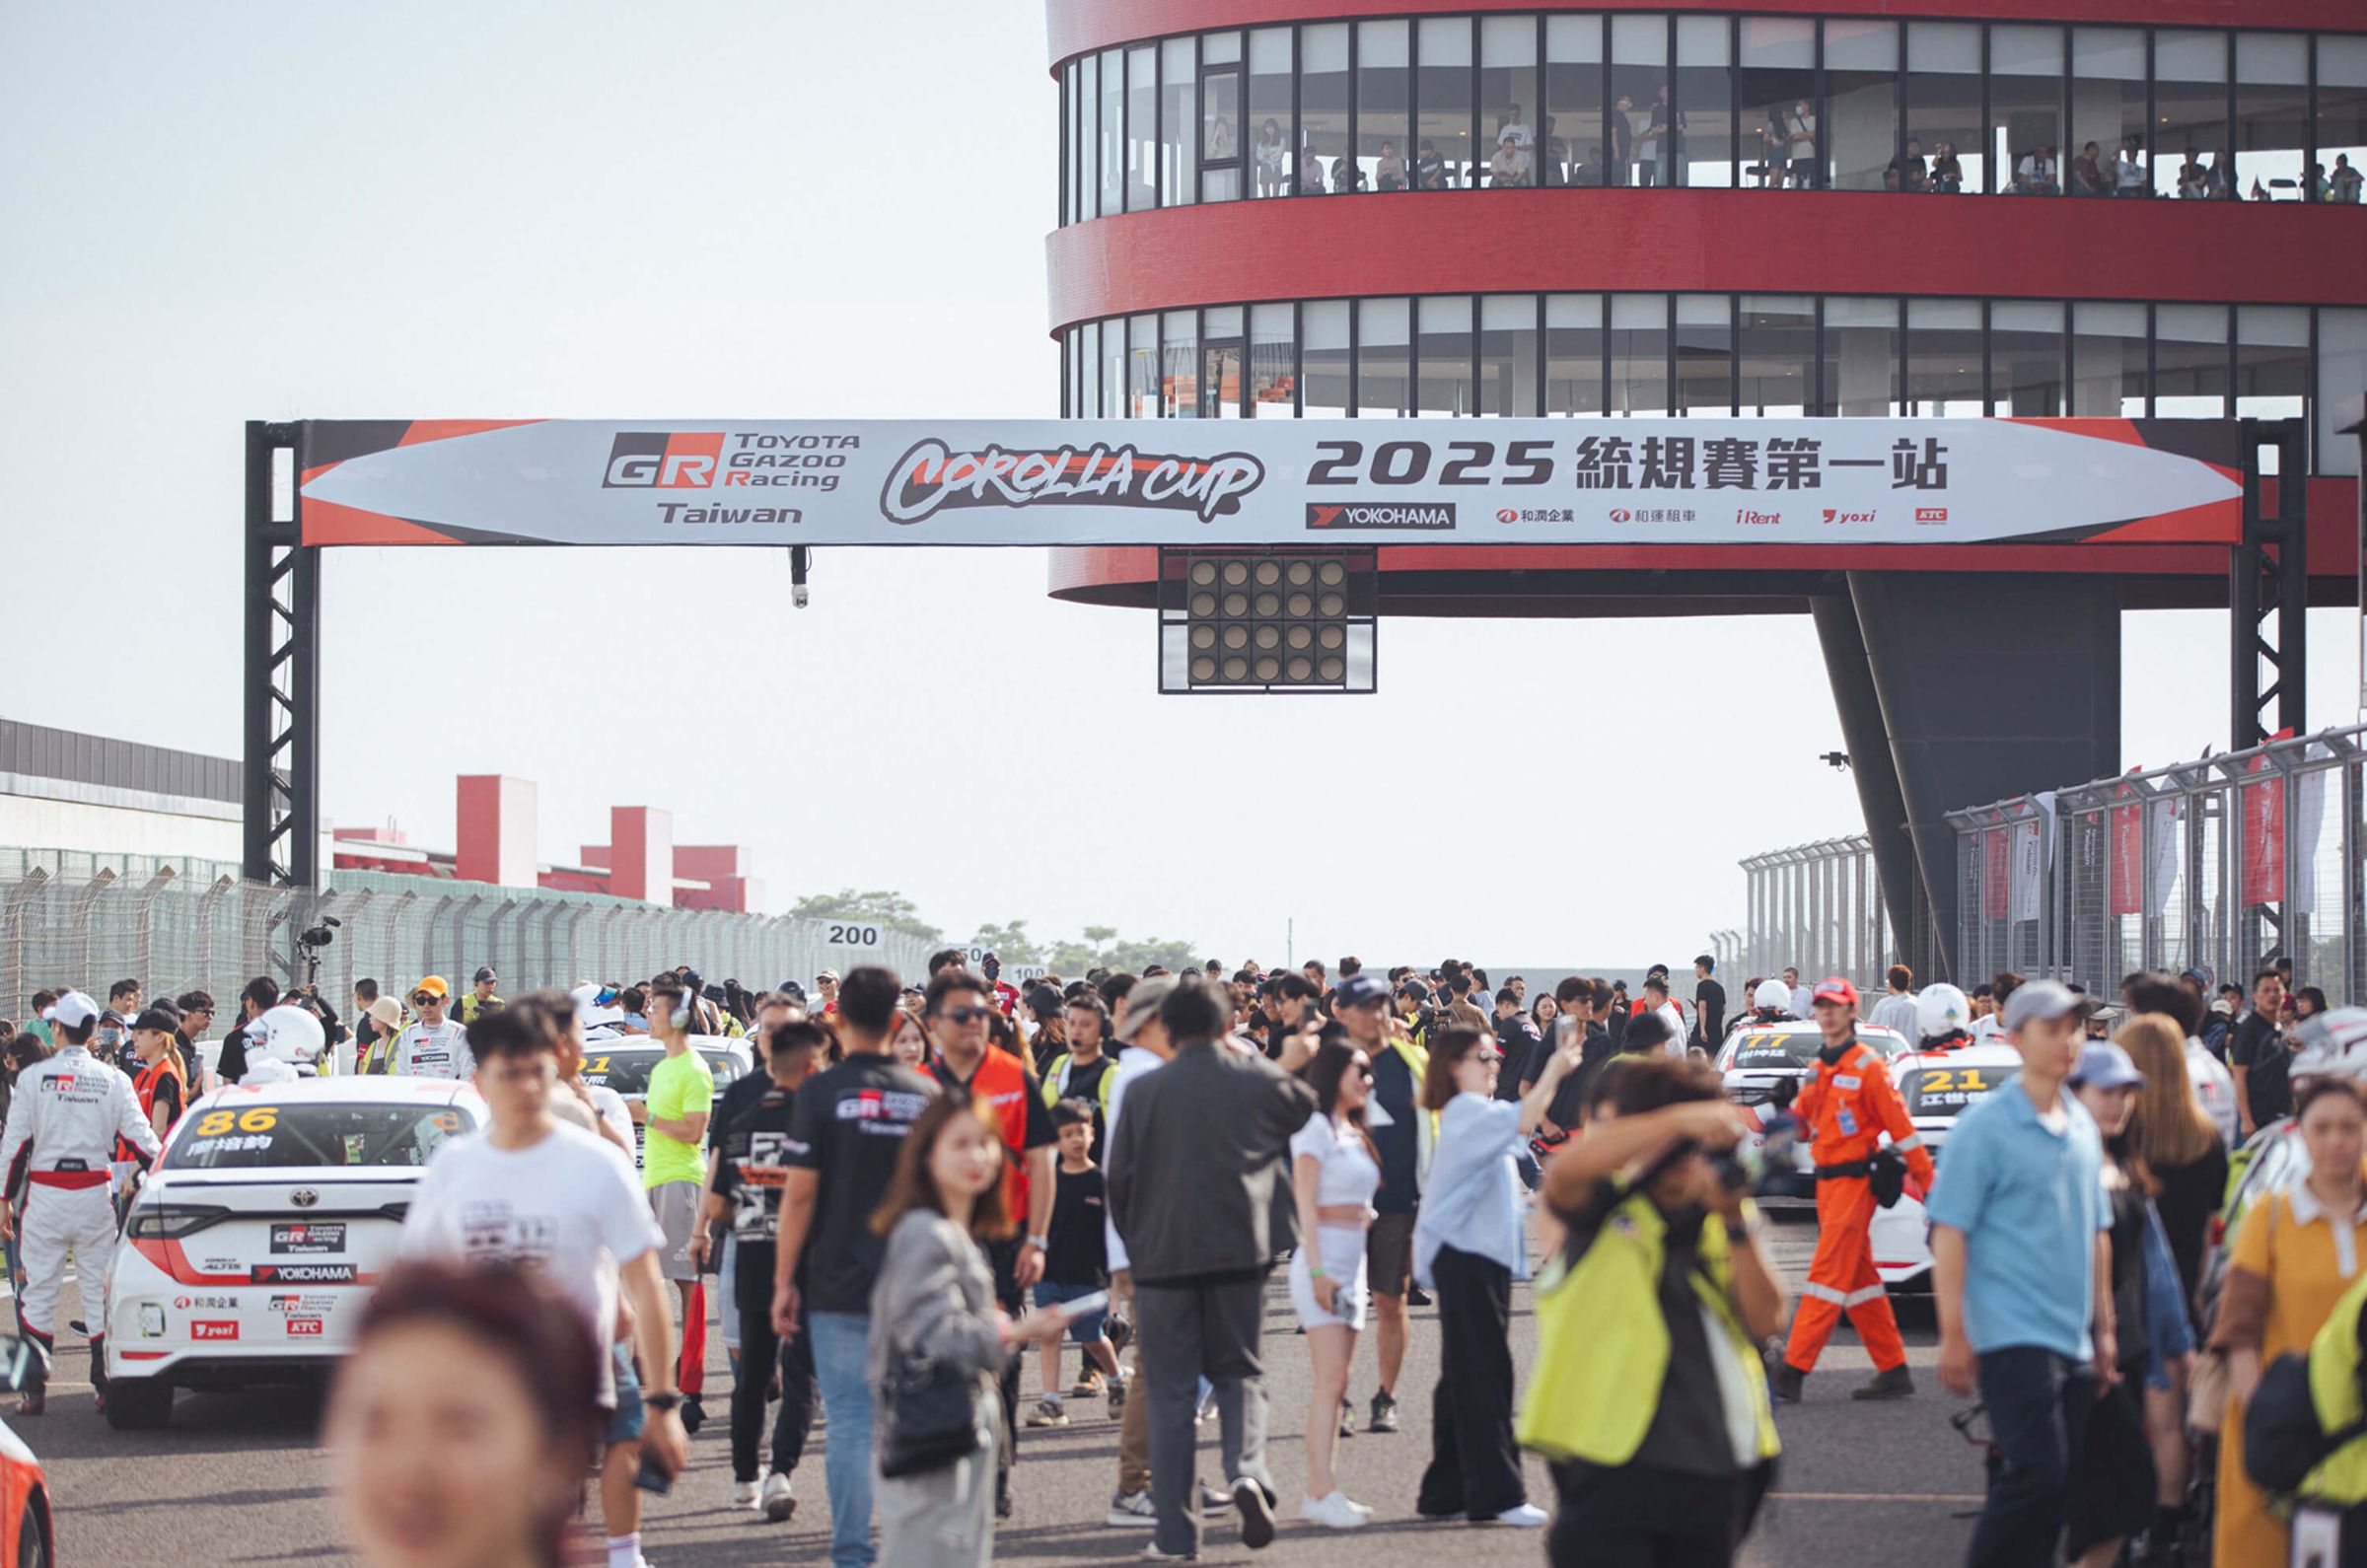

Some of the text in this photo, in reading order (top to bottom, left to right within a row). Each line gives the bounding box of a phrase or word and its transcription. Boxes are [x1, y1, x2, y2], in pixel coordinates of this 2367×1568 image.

[735, 433, 860, 449] TOYOTA
[729, 453, 846, 467] GAZOO
[1306, 436, 1948, 490] 2025 統規賽第一站
[607, 455, 716, 485] GR
[725, 470, 839, 491] Racing
[887, 440, 1259, 521] COROLLA CUP
[657, 503, 803, 524] Taiwan
[1345, 508, 1450, 524] YOKOHAMA
[1521, 509, 1575, 523] 和潤企業
[1634, 509, 1696, 523] 和運租車
[1839, 509, 1876, 524] yoxi
[829, 925, 878, 945] 200
[1015, 968, 1045, 979] 100
[1746, 1034, 1792, 1049] 77
[1921, 1069, 1988, 1093] 21
[196, 1107, 279, 1136] 86
[278, 1267, 353, 1280] YOKOHAMA
[207, 1323, 235, 1337] yoxi
